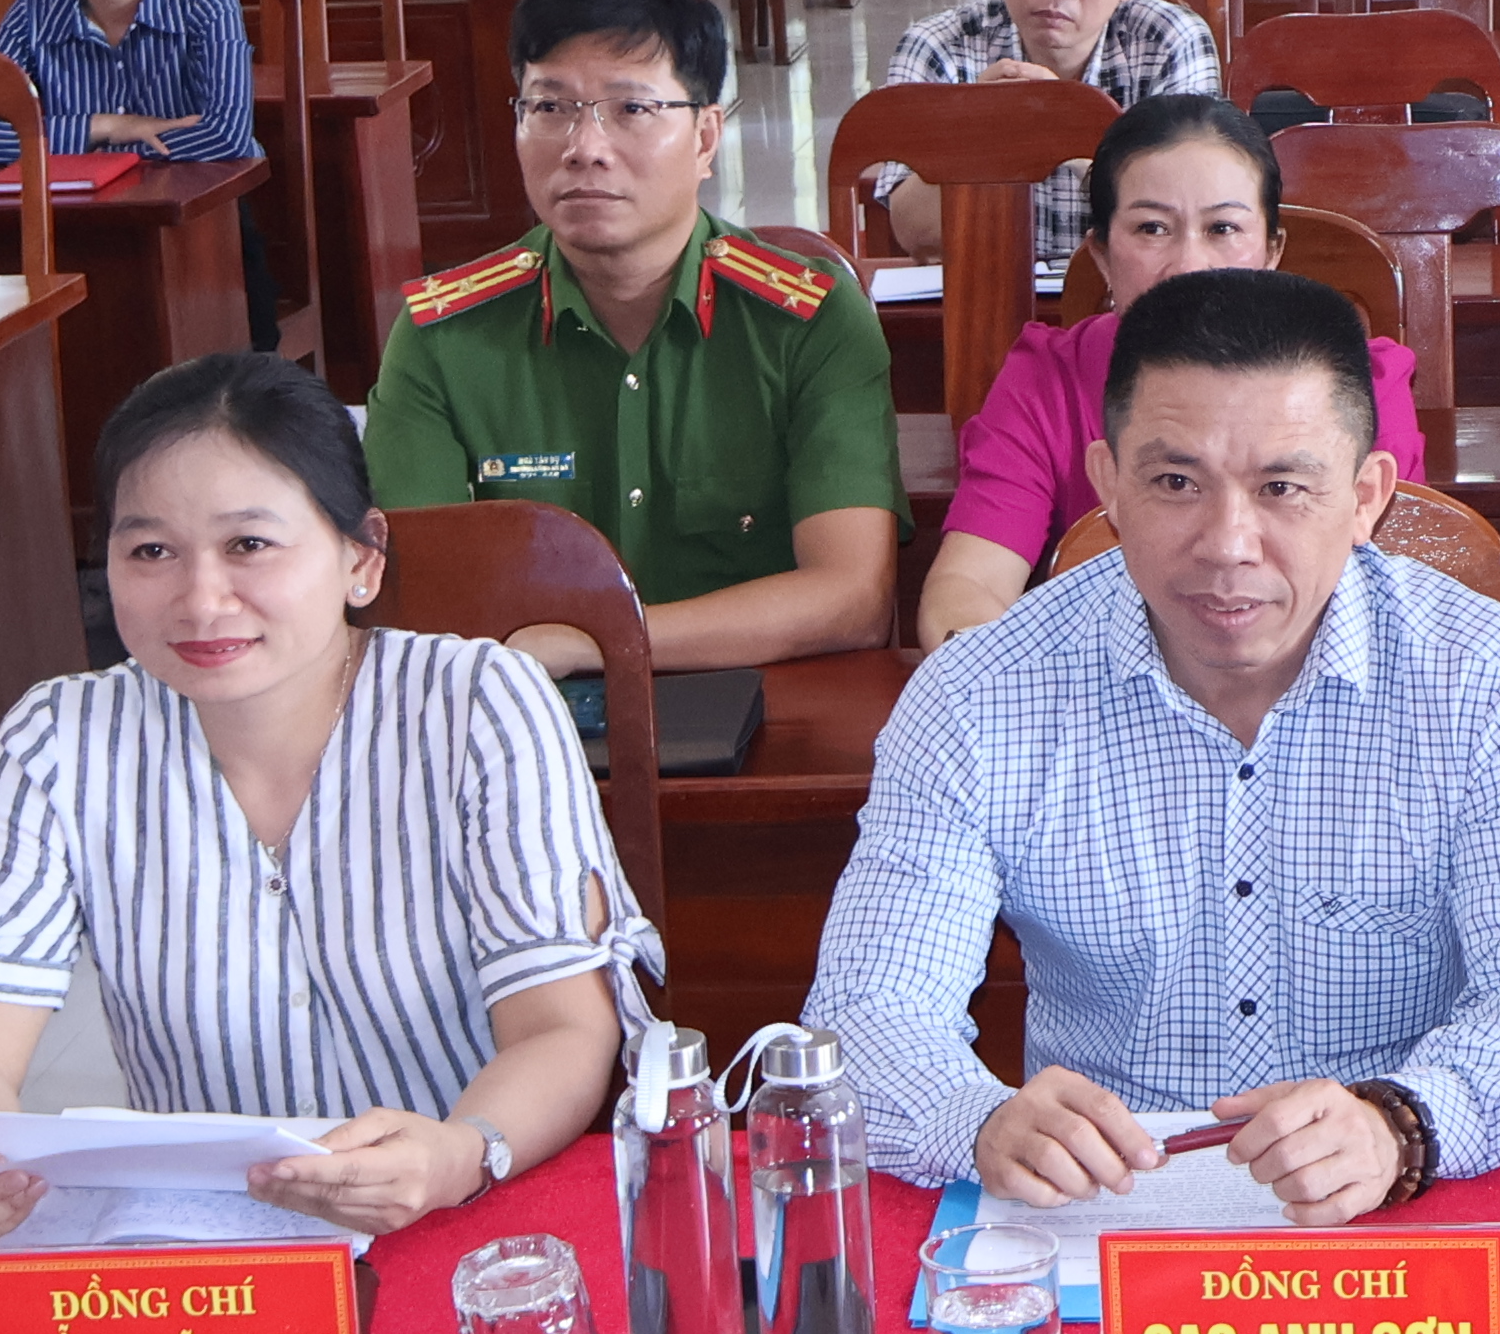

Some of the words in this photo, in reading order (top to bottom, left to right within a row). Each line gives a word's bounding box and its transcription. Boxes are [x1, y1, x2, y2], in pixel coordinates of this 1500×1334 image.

[49, 1273, 170, 1321] ĐỒNG
[181, 1275, 257, 1317] CHÍ
[1200, 1254, 1321, 1301] ĐỒNG
[1332, 1260, 1409, 1299] CHÍ
